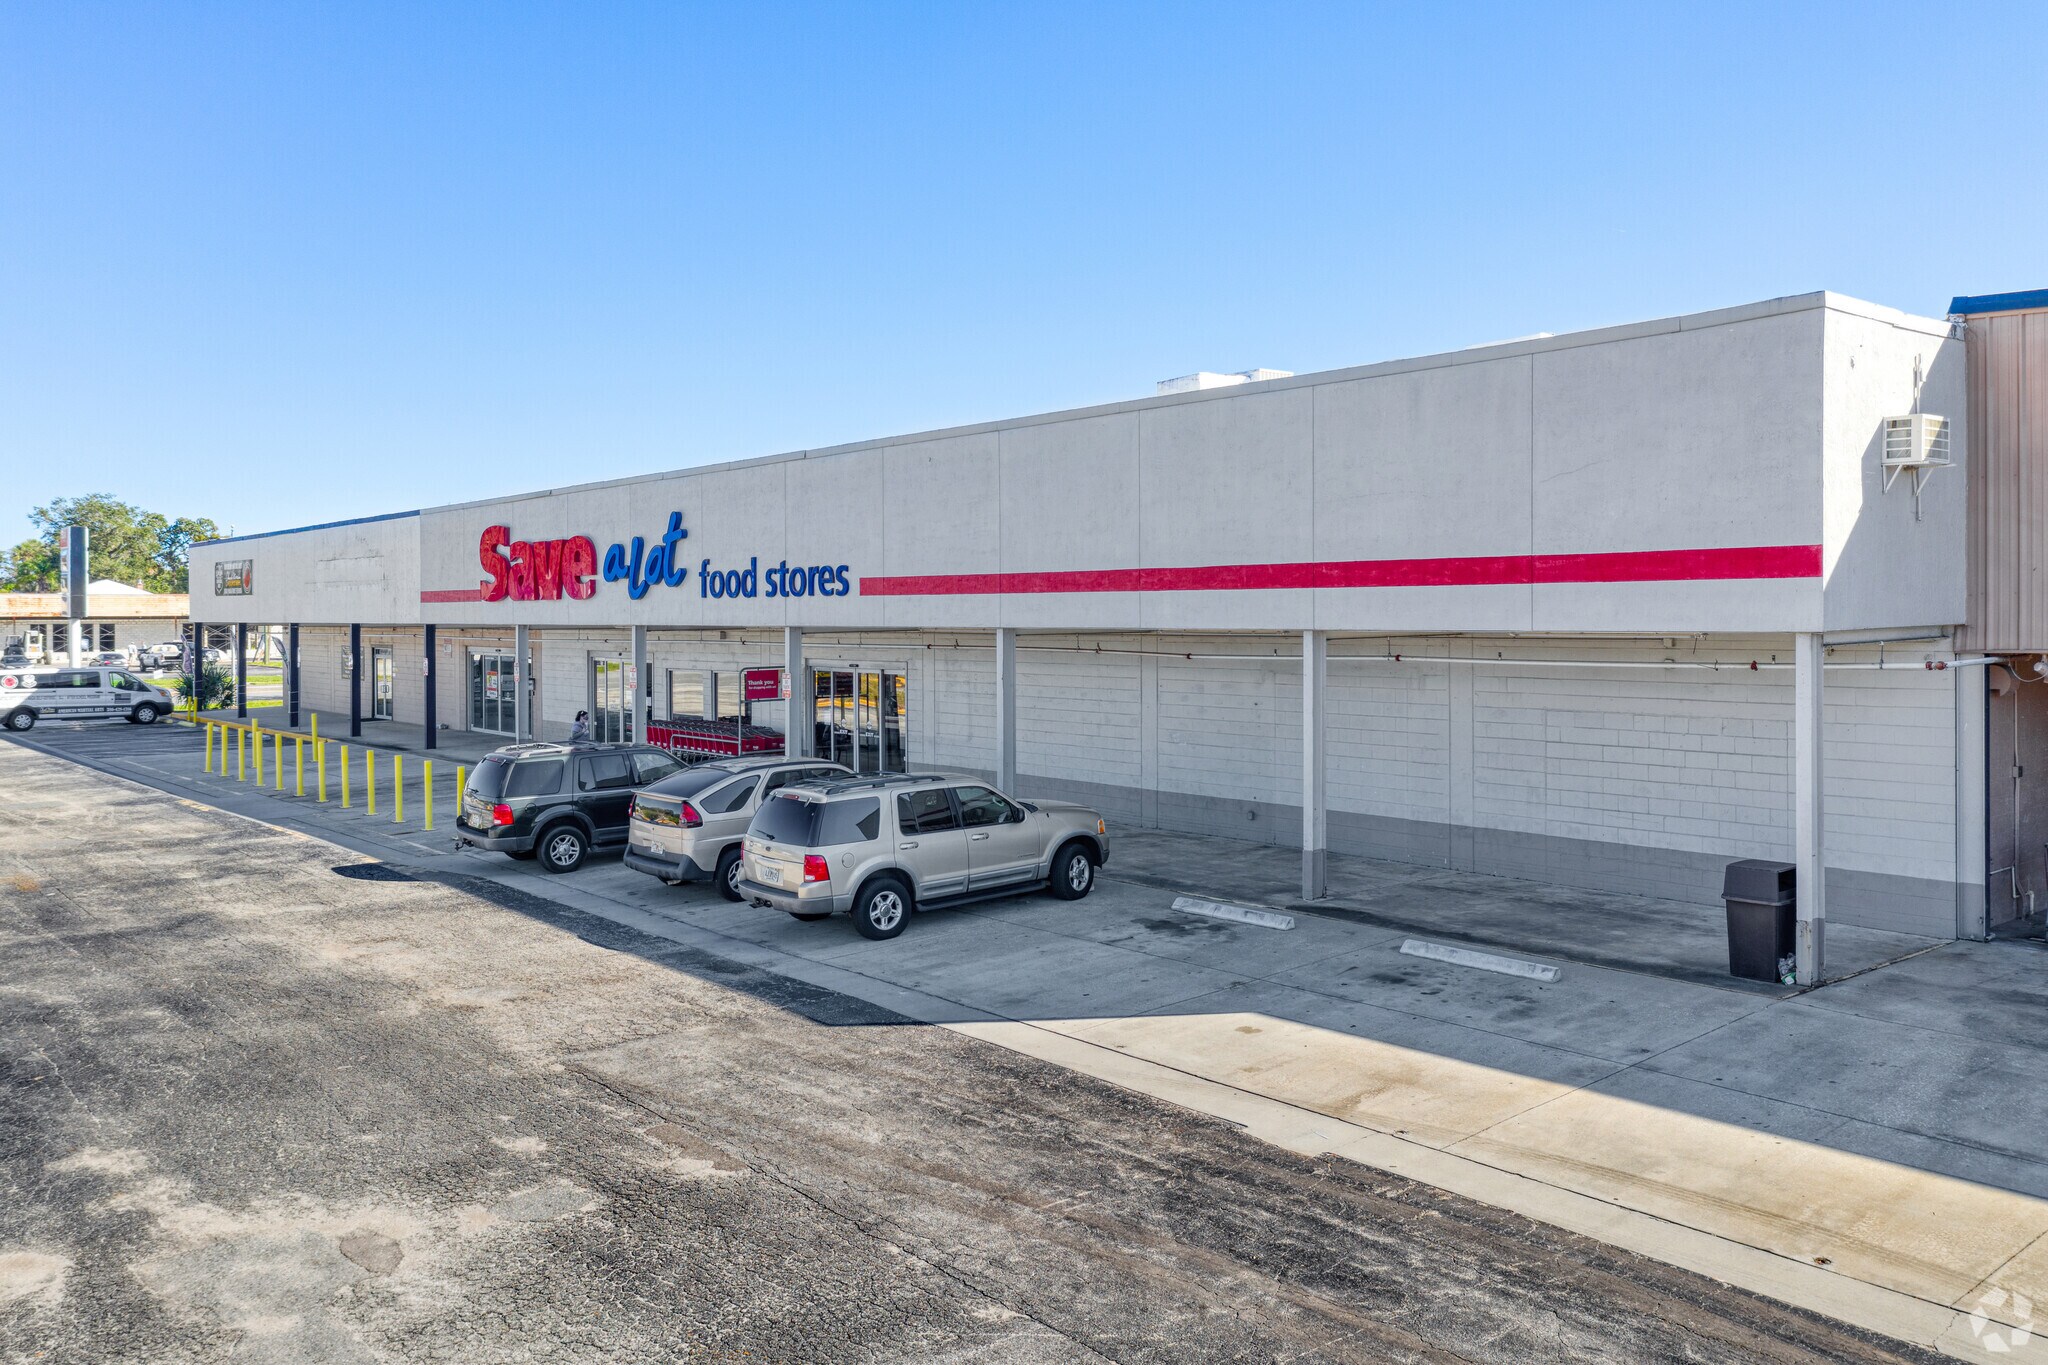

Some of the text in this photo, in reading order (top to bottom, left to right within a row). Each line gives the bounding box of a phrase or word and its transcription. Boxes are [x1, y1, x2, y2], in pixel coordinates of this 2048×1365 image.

[480, 525, 596, 602] Save
[699, 557, 850, 599] food stores
